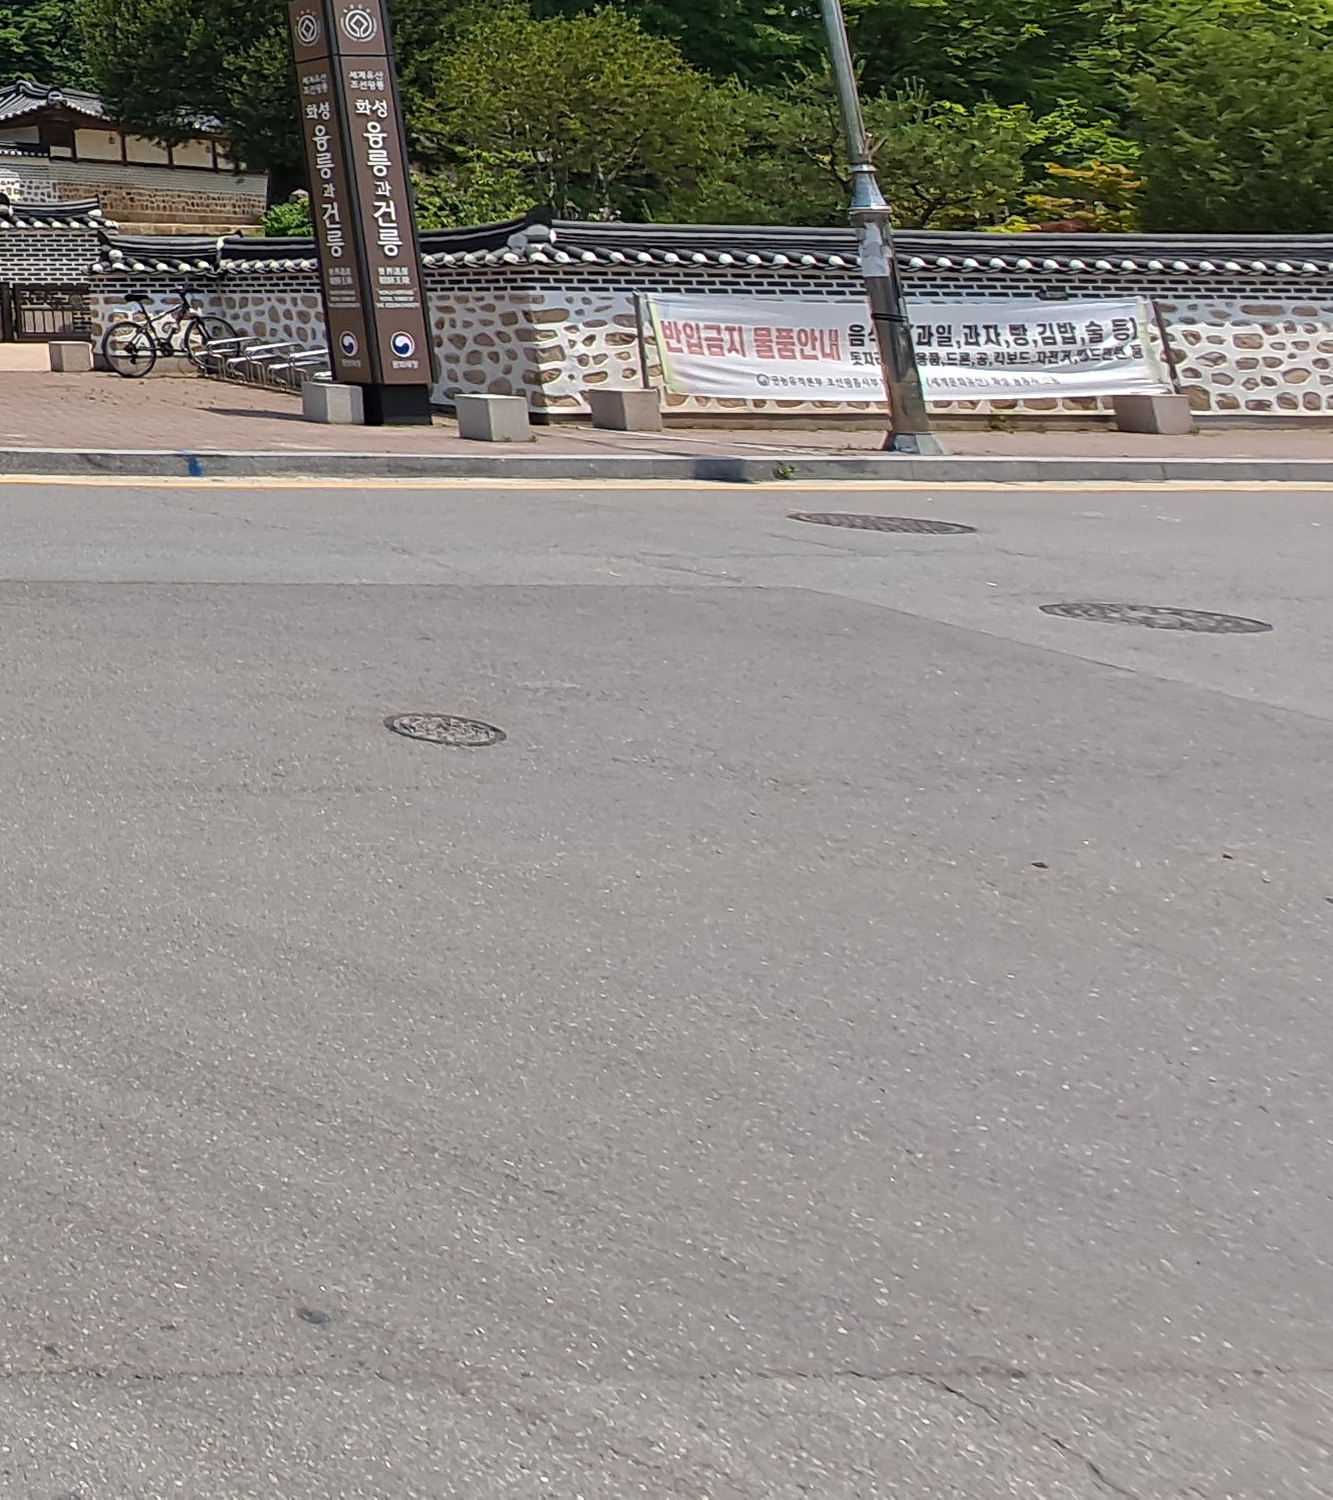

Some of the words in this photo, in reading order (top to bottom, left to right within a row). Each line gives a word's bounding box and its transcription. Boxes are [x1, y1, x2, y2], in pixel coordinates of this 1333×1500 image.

[306, 101, 330, 120] 화성
[354, 99, 388, 118] 화성
[321, 201, 345, 257] 건릉
[373, 200, 403, 257] 건릉
[660, 320, 746, 358] 반입금지
[753, 326, 842, 361] 물품안내
[1111, 315, 1139, 342] 등)
